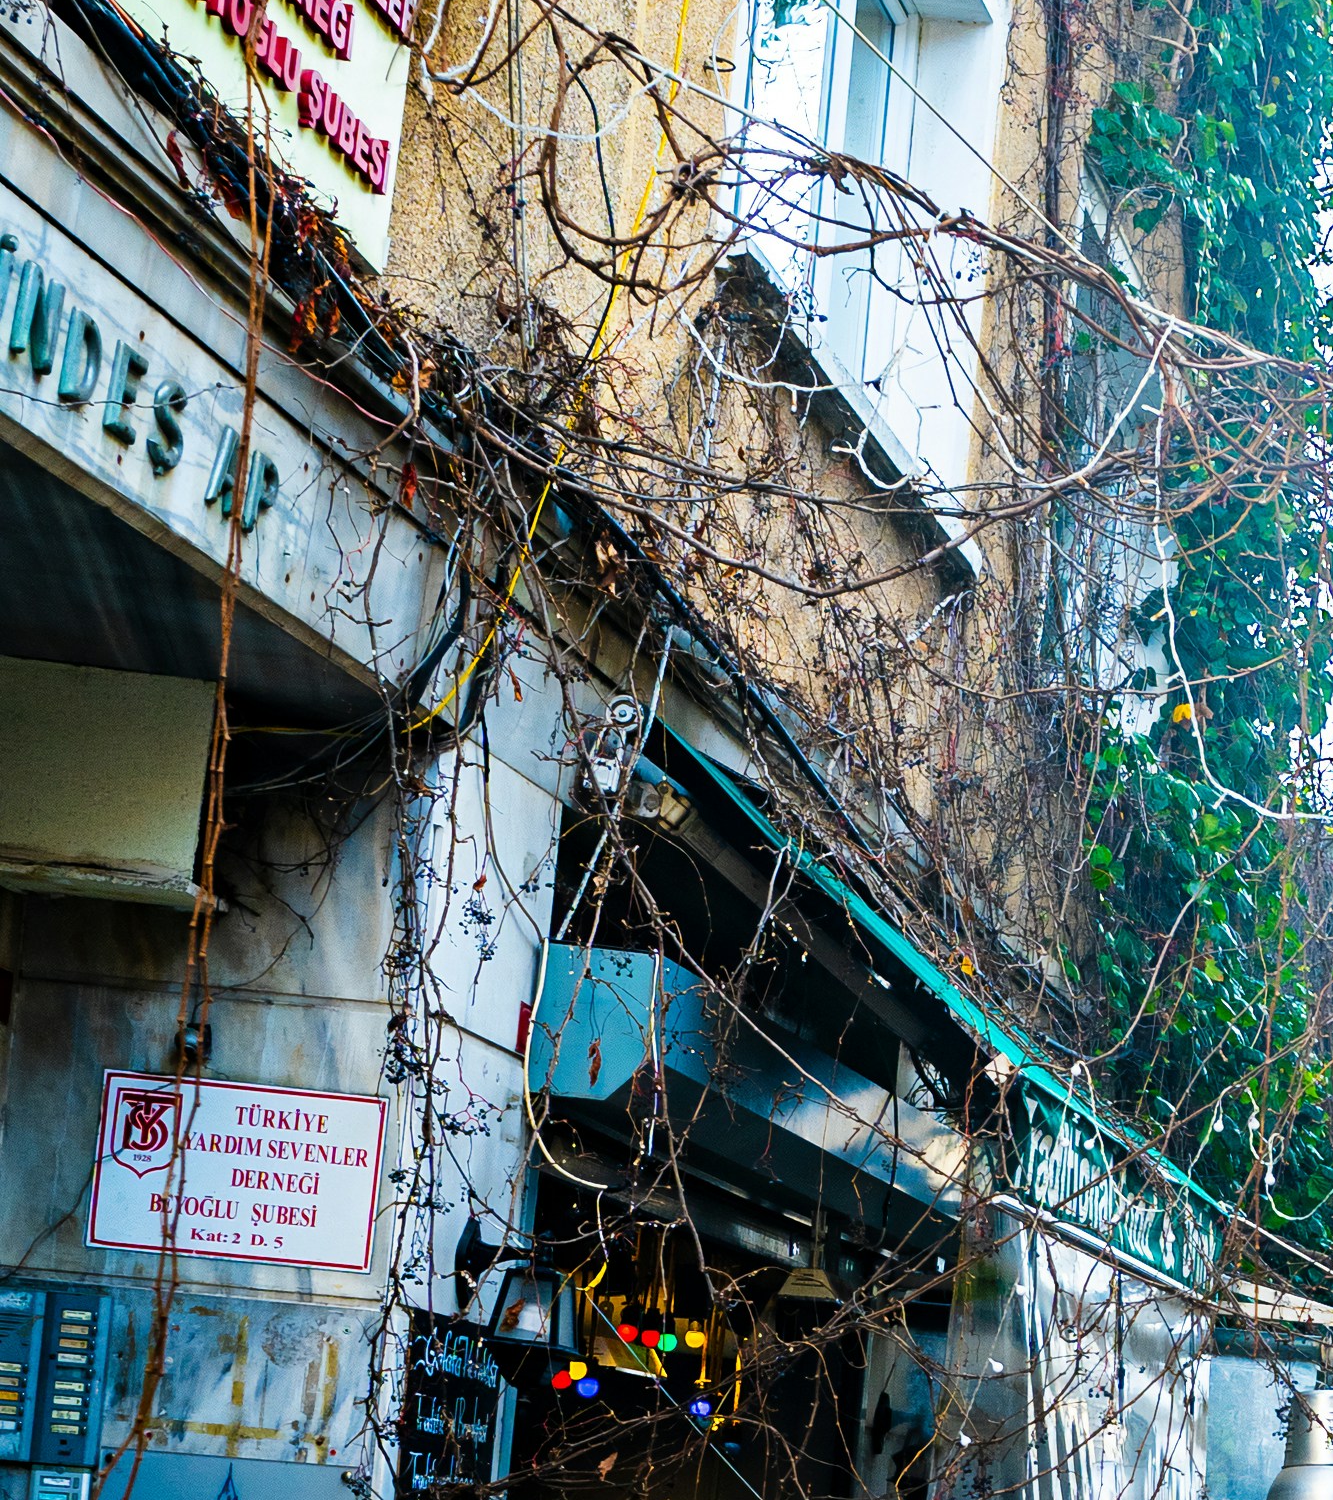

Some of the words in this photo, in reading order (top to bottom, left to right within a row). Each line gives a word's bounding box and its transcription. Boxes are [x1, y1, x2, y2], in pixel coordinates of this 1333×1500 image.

[298, 68, 392, 195] ŞUBESİ
[235, 1104, 329, 1134] TÜRKİYE
[132, 1153, 152, 1163] 1928
[184, 1132, 263, 1157] YARDIM
[267, 1139, 369, 1168] SEVENLER
[231, 1168, 321, 1196] DERNEĞİ
[148, 1193, 240, 1220] BEYOĞLU
[250, 1202, 318, 1228] ŞUBESİ
[250, 1233, 268, 1248] D.
[273, 1236, 284, 1249] 5
